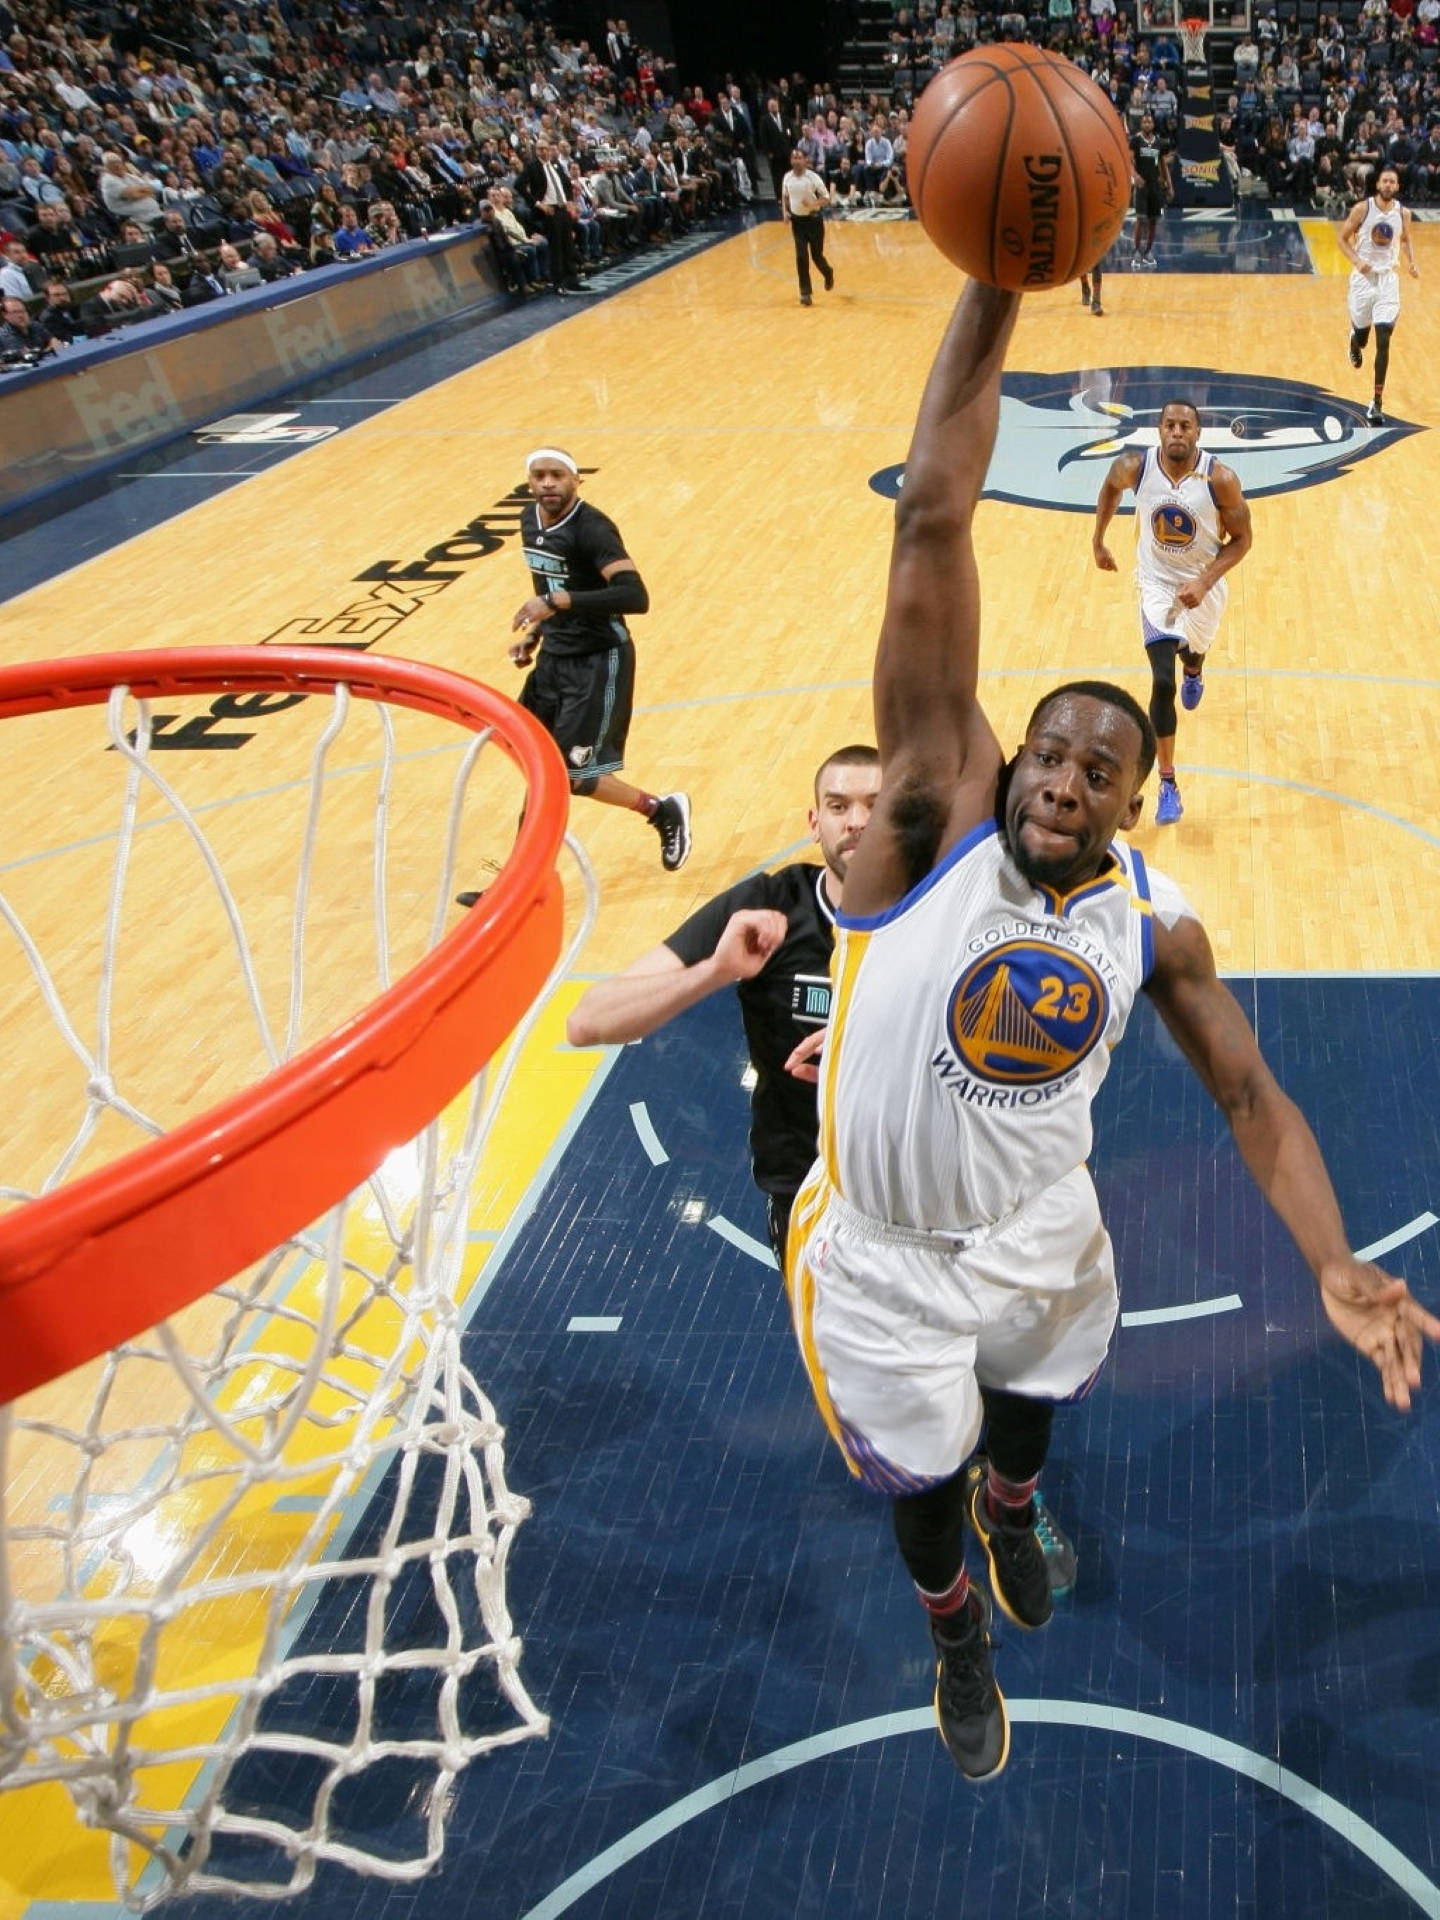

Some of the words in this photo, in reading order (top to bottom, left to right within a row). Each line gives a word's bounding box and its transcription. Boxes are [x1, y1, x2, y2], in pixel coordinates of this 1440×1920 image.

[1022, 155, 1063, 286] PALDING
[968, 922, 1059, 954] GOLDEN
[1067, 933, 1120, 991] STATE
[1031, 975, 1092, 1024] 23
[931, 1048, 1081, 1108] WARRIORS
